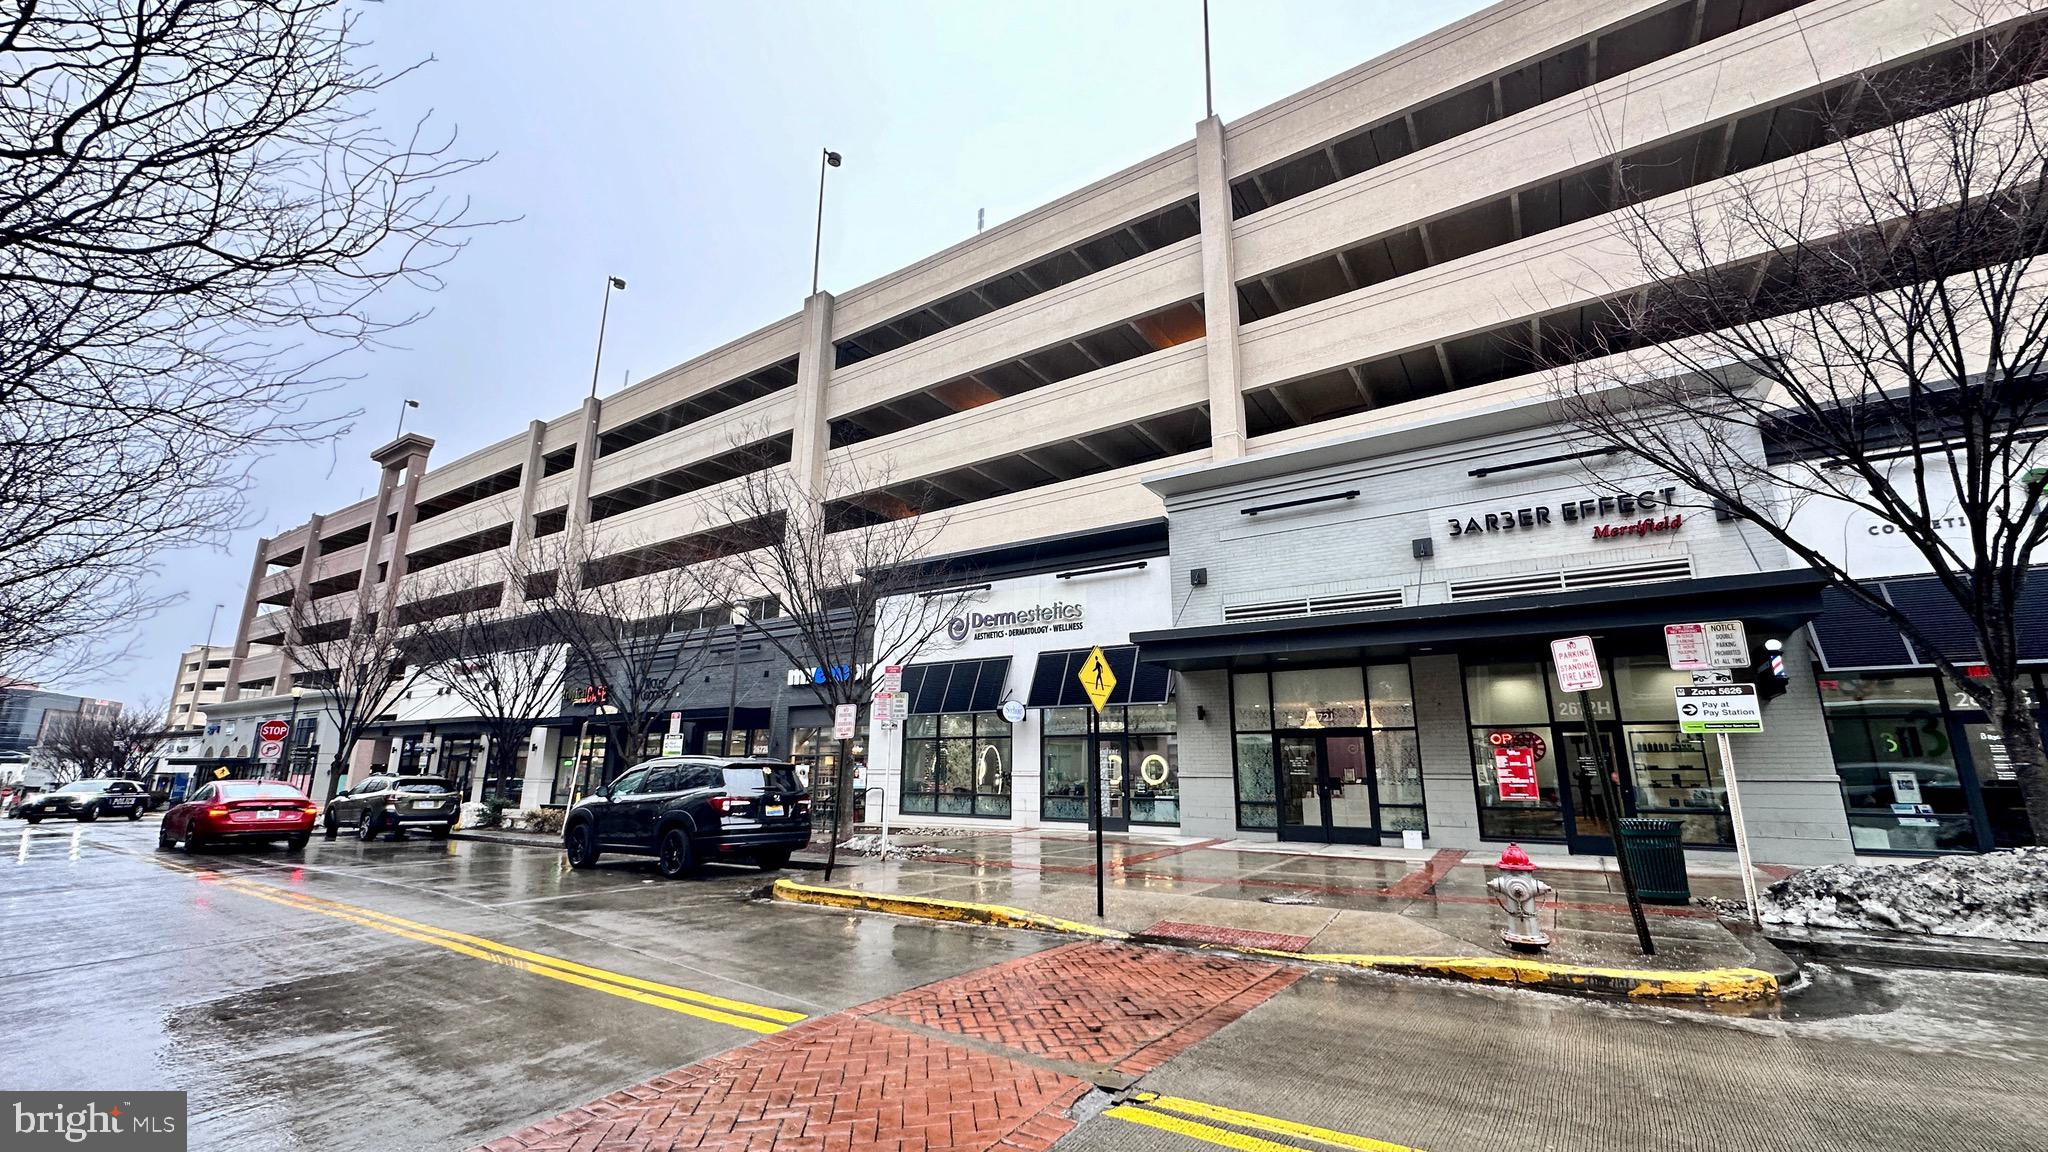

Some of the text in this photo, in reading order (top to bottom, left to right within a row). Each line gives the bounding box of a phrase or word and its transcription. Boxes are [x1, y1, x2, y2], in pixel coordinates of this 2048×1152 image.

[1561, 486, 1677, 521] EFFECT
[1592, 514, 1683, 539] Merrifield
[971, 601, 1083, 628] Dermestetics
[974, 622, 1083, 640] AESTHETICS DERMATOLOGY WELLNESS
[1710, 623, 1736, 632] NOTICE
[1566, 641, 1577, 650] NO
[1559, 649, 1589, 659] PARKING
[1560, 661, 1594, 672] STANDING
[1562, 670, 1596, 681] FIRE LANE
[1690, 688, 1717, 696] Zone
[1702, 701, 1718, 709] Pay
[1721, 708, 1755, 716] Station
[262, 726, 287, 735] STOP
